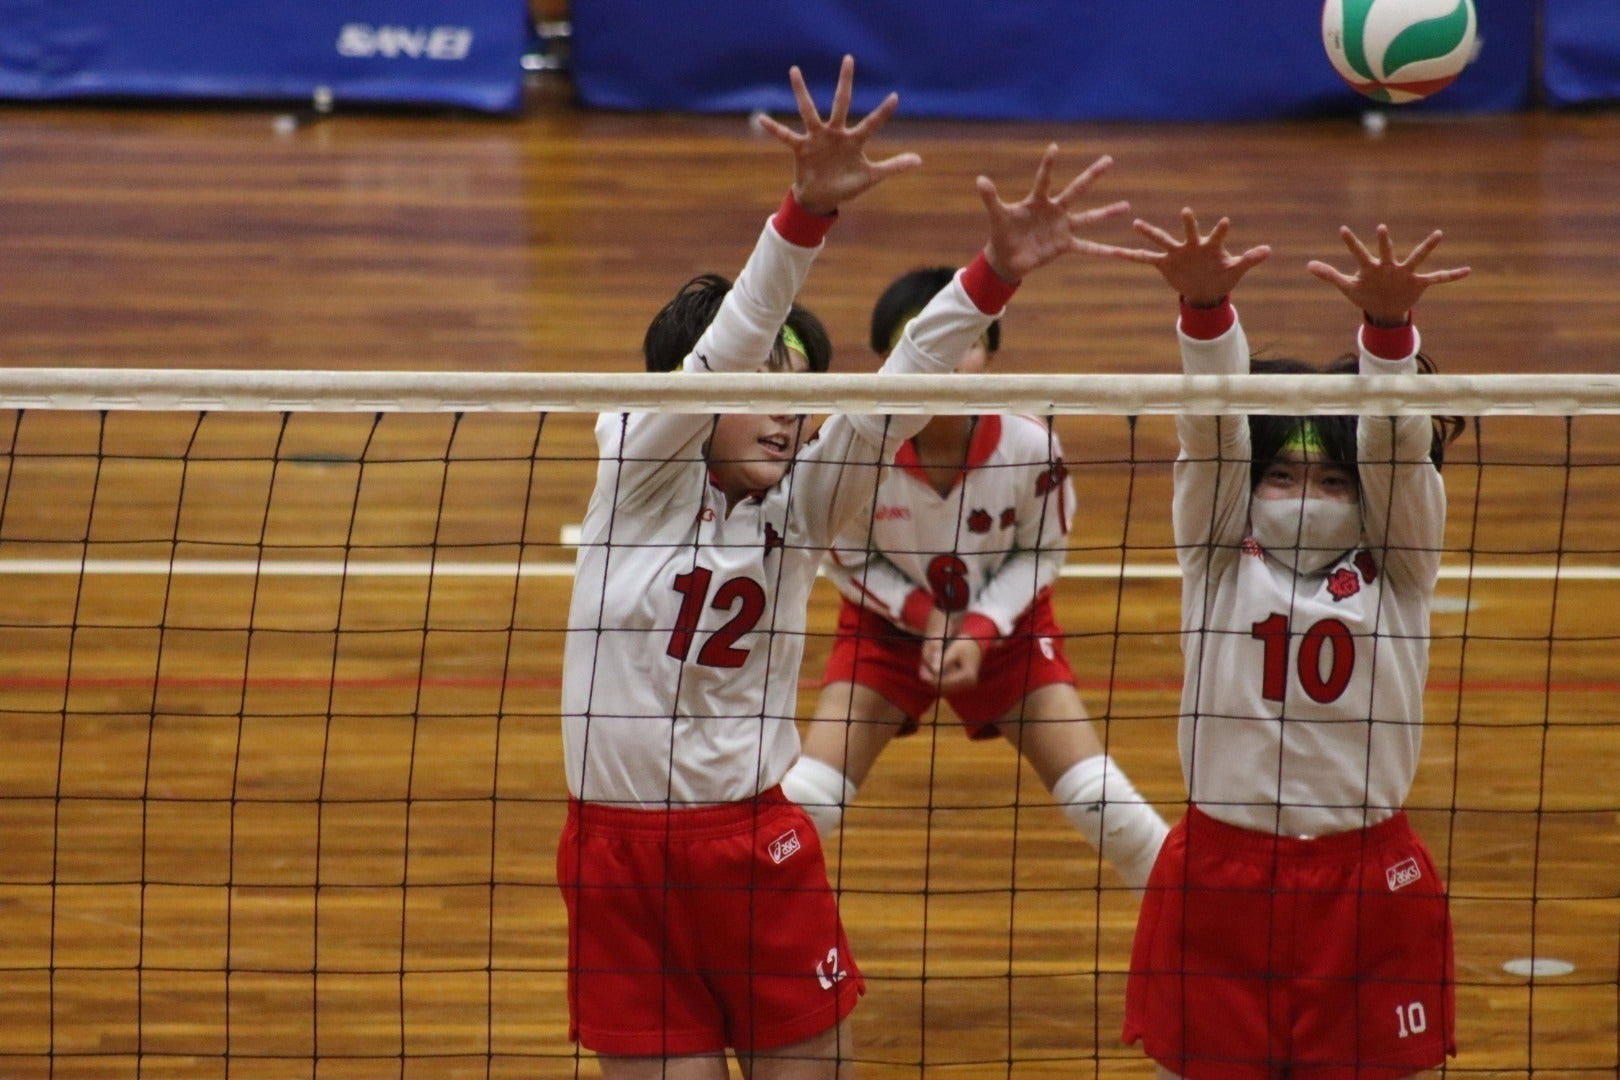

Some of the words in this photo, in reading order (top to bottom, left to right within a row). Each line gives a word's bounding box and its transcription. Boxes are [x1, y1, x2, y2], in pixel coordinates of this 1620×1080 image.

[666, 566, 766, 668] 12
[928, 555, 970, 613] 6
[1252, 612, 1356, 704] 10
[1396, 1002, 1426, 1038] 10
